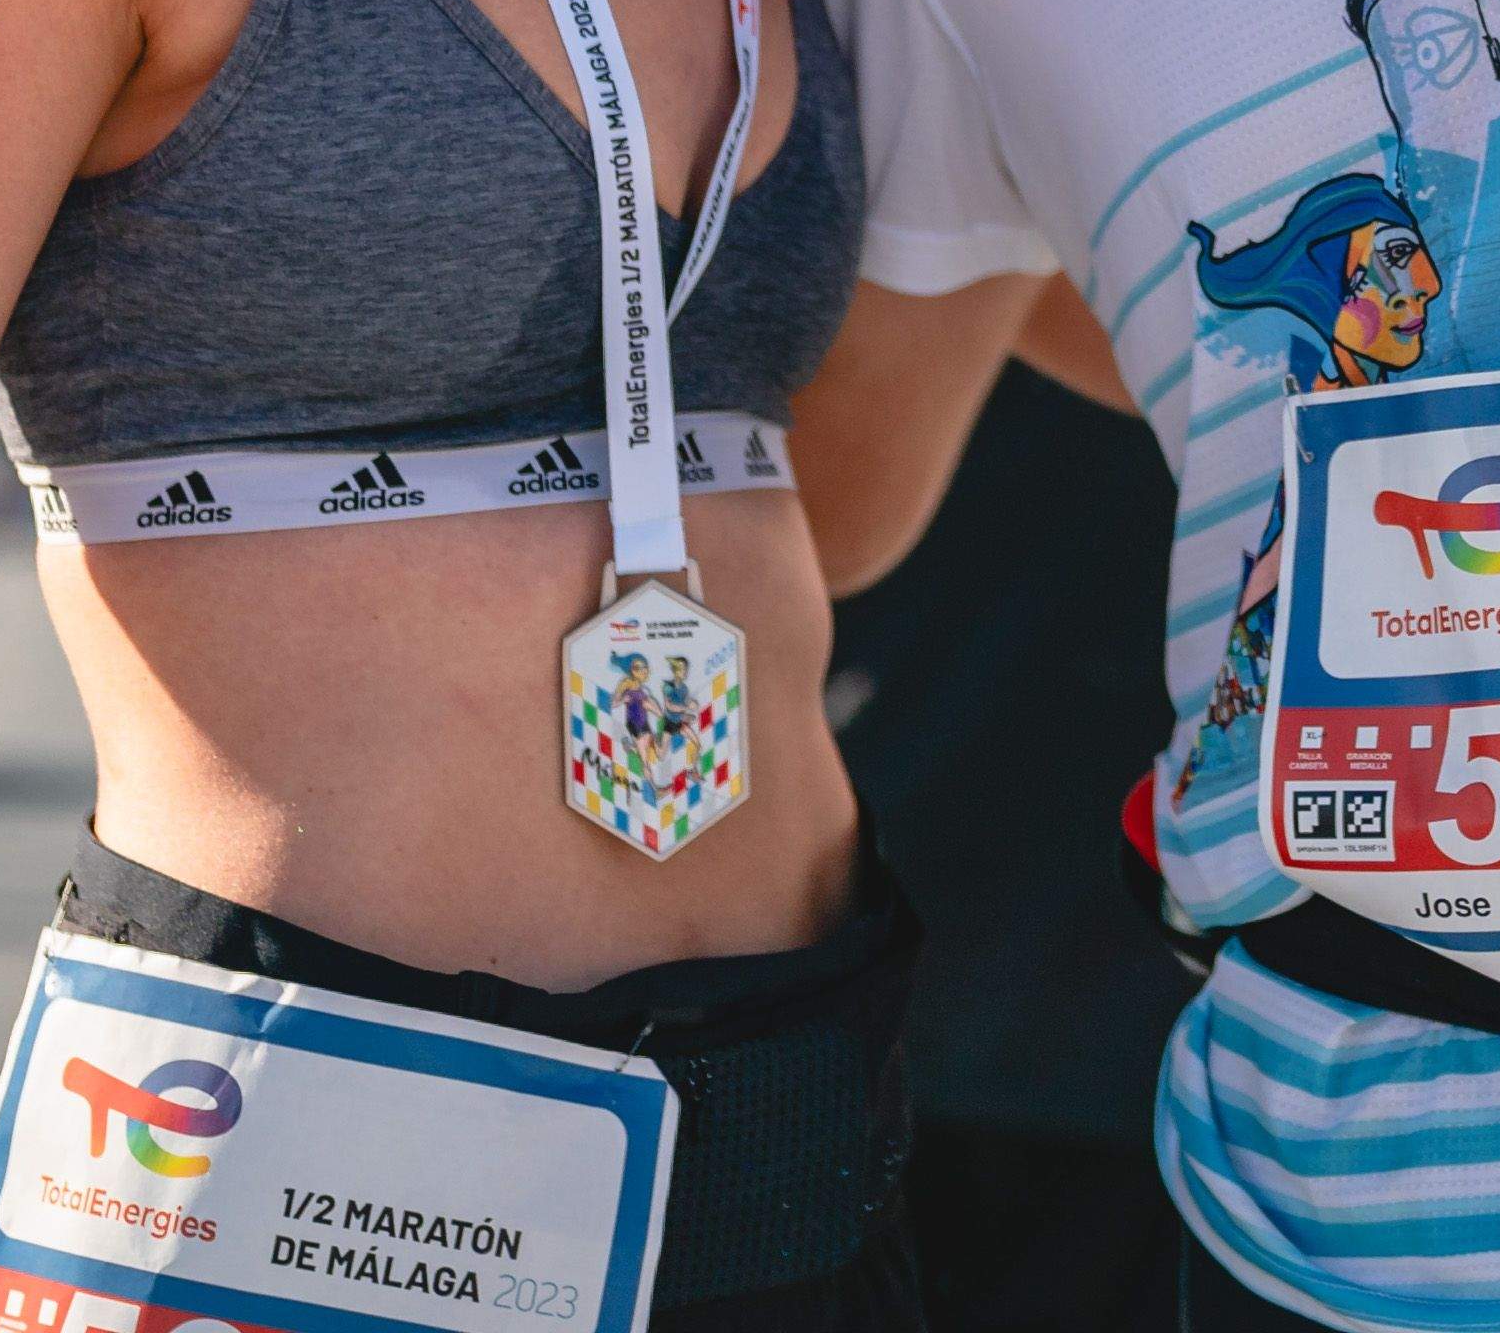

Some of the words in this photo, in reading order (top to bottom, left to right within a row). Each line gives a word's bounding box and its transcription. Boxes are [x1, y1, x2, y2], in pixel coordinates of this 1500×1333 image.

[586, 43, 627, 130] MÁLAGA
[609, 131, 640, 244] MARATÓN
[621, 248, 640, 285] 1/2
[623, 290, 650, 449] TotalEnergies
[137, 503, 232, 528] adidas
[319, 488, 426, 515] adidas
[508, 470, 600, 496] adidas
[1415, 892, 1492, 919] Jose
[38, 1174, 219, 1243] TotalEnergies
[281, 1186, 335, 1229] 1/2
[342, 1195, 523, 1261] MARATÓN
[270, 1234, 316, 1272] DE
[326, 1242, 480, 1303] MÁLAGA
[491, 1273, 580, 1320] 2023
